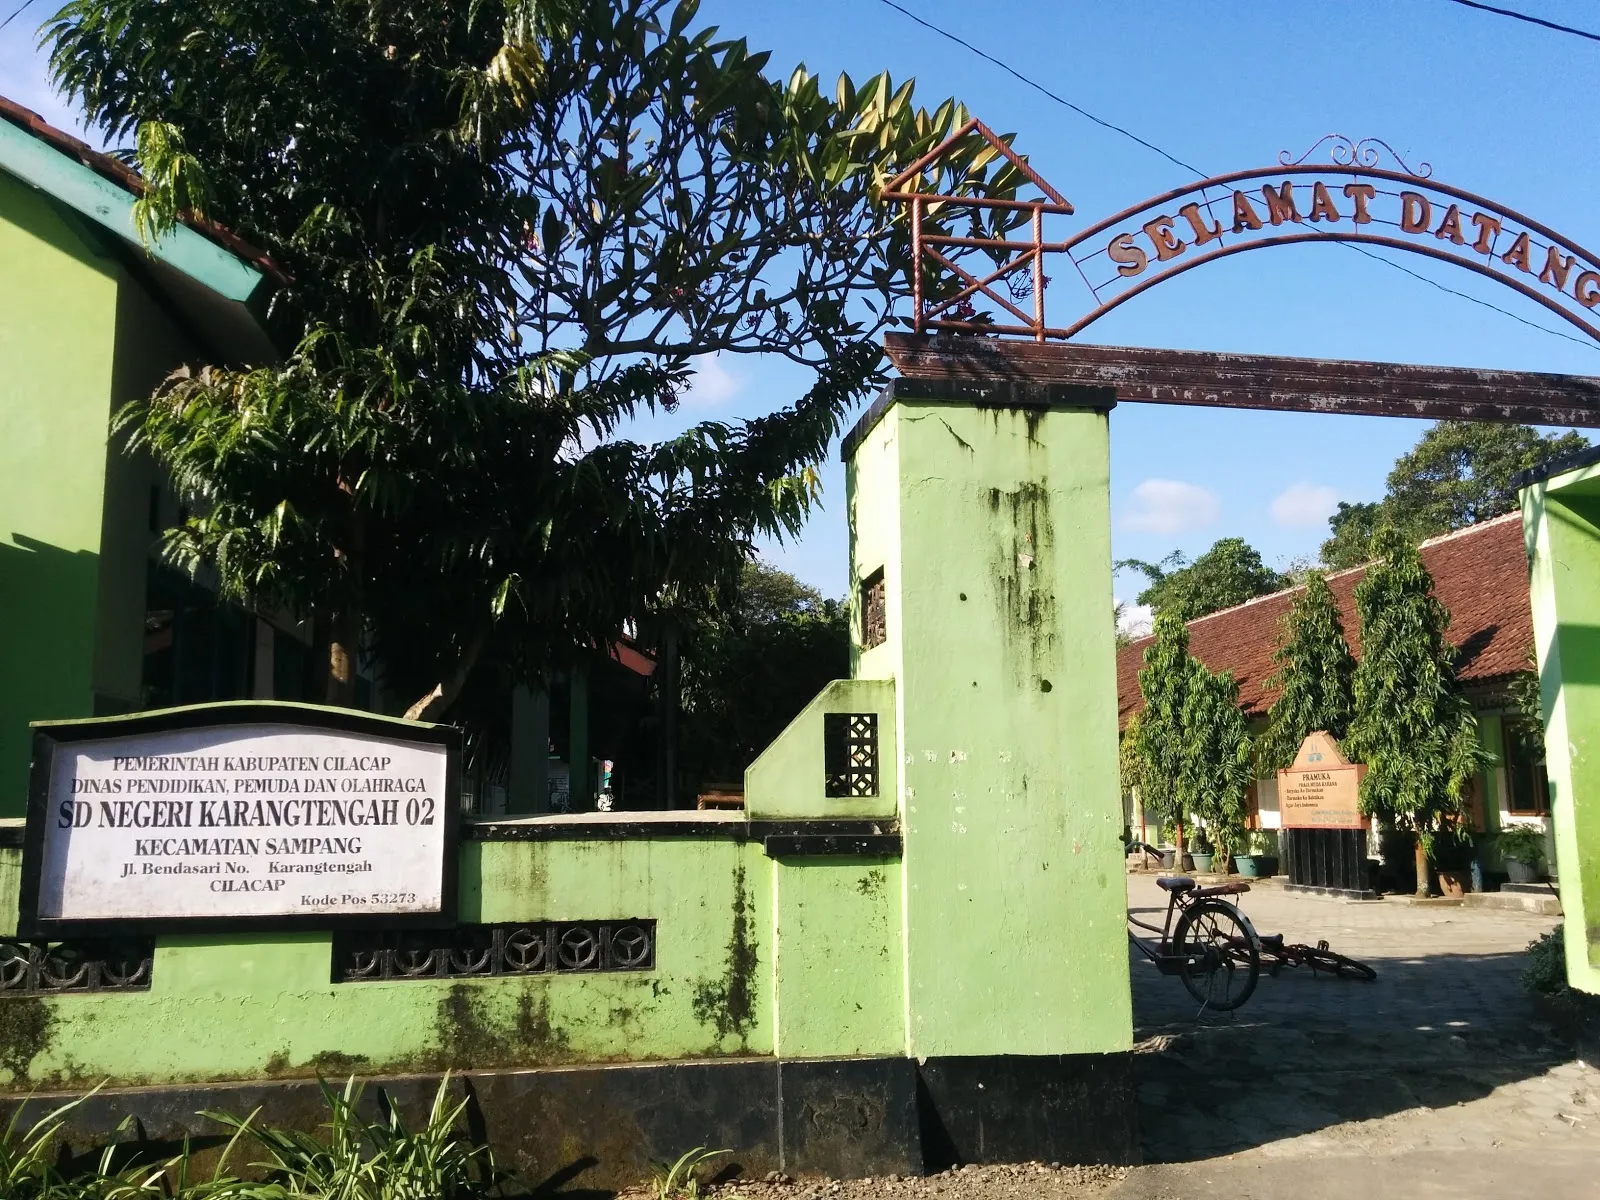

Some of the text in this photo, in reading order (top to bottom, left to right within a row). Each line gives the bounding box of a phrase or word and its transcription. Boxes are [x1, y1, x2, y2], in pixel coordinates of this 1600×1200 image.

[1107, 181, 1600, 308] SELAMAT DATANG
[113, 756, 390, 772] PEMERINTAH KABUPATEN CILACAP
[1303, 773, 1330, 781] PRAMUKA
[71, 778, 426, 796] DINAS PENDIDIKAN, PEMUDA DAN OLAHRAGA
[58, 797, 435, 829] SD NEGERI KARANGTENGAH 02
[135, 837, 361, 856] KECAMATAN SAMPANG
[121, 860, 372, 878] Jl. Bendasari No. Karangtengah
[209, 880, 285, 892] CILACAP
[301, 893, 416, 906] Kode Pos 53273
